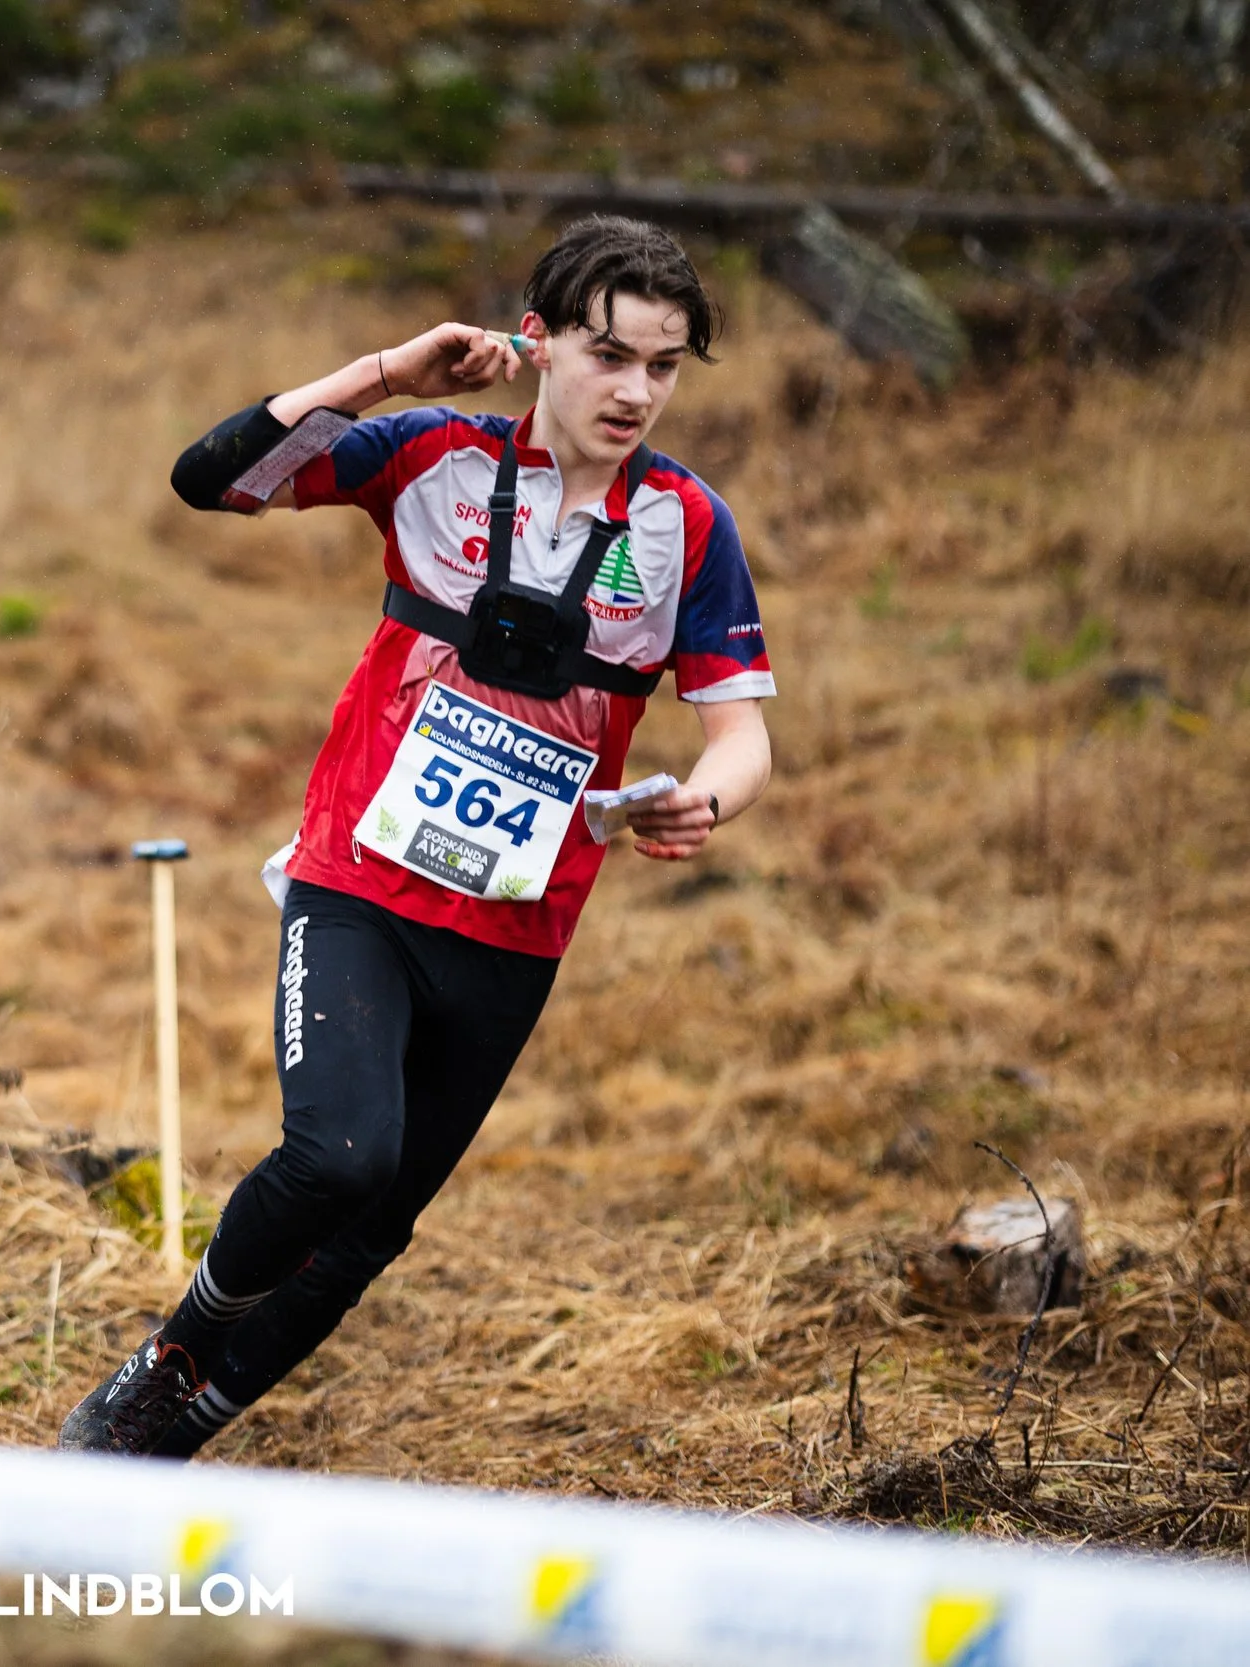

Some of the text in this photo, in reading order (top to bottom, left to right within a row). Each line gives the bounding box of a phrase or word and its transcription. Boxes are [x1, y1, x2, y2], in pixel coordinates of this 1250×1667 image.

[424, 688, 589, 784] bagheera
[430, 728, 511, 774] KOLMÅRDSMEDELN
[414, 755, 542, 848] 564
[415, 839, 485, 877] AVLOPP
[423, 827, 488, 866] GODKÄNDA
[282, 916, 309, 1071] bagheera
